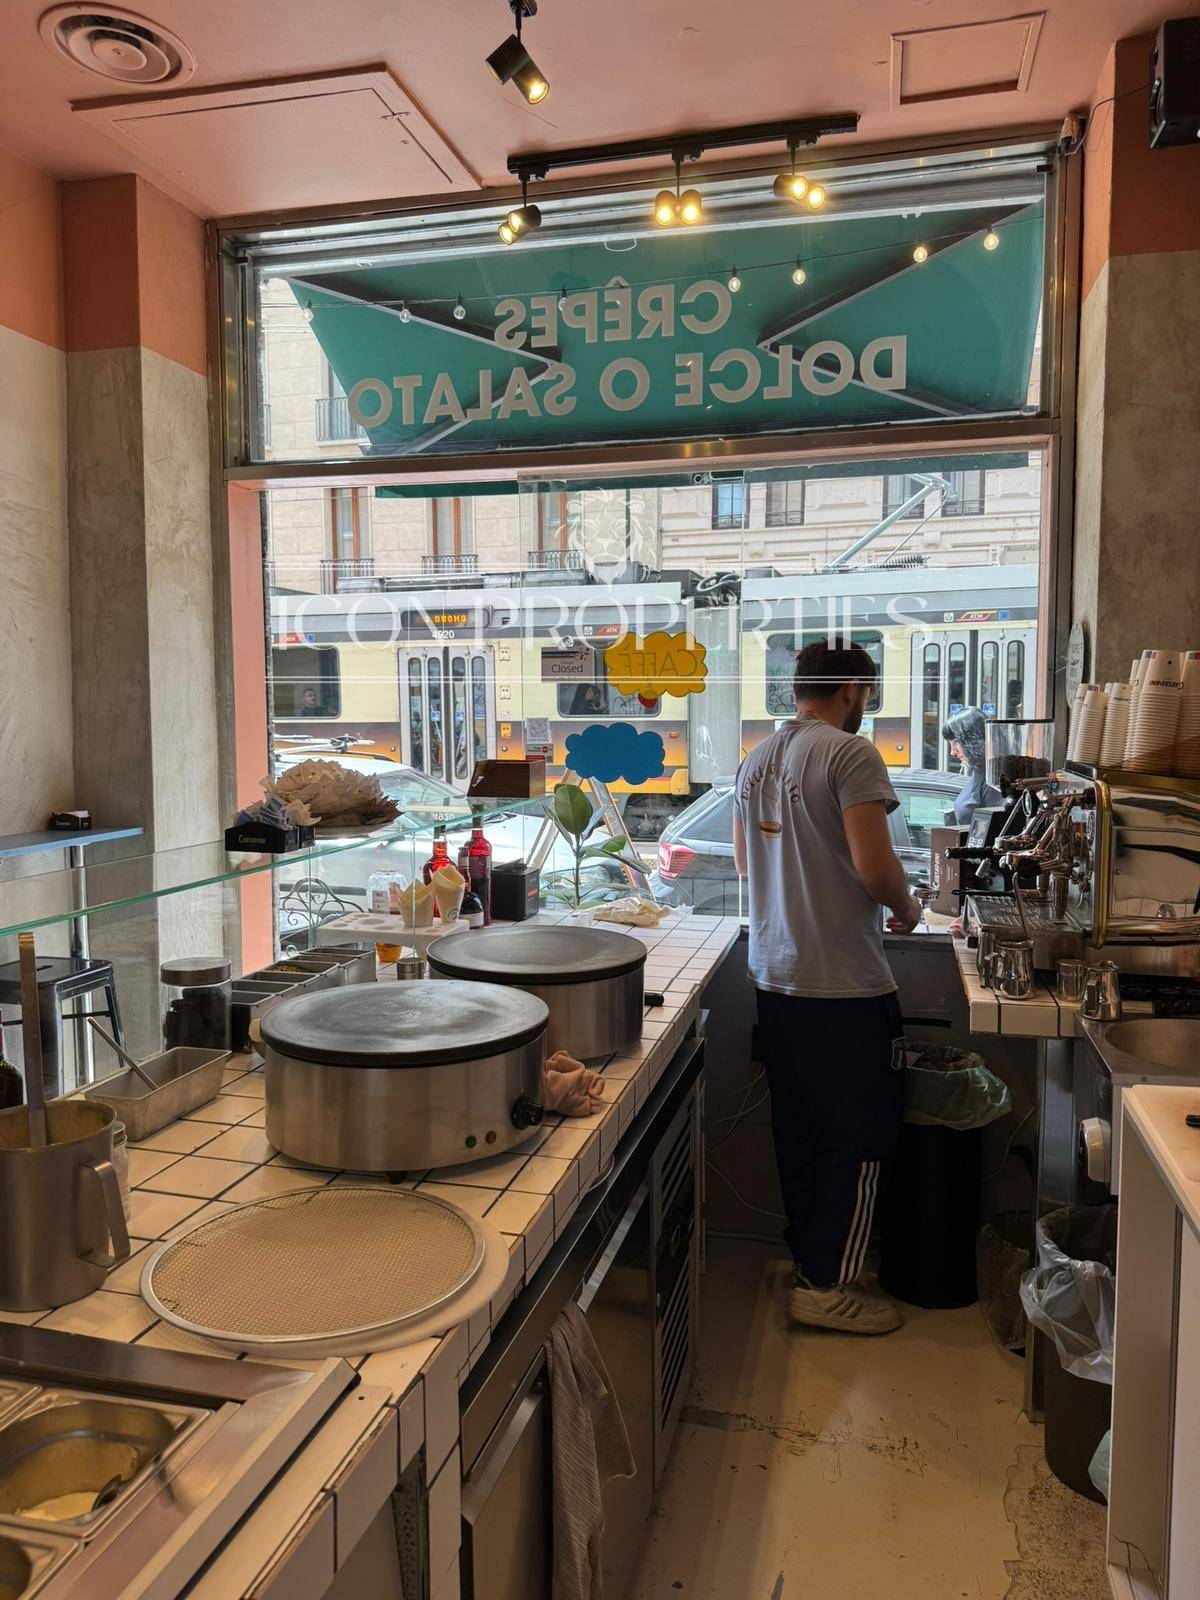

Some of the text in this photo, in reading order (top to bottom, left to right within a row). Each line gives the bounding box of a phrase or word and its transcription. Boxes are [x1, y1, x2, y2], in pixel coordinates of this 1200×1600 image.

[434, 614, 467, 623] DUOMO
[431, 630, 455, 639] 4920
[551, 663, 584, 673] Closed
